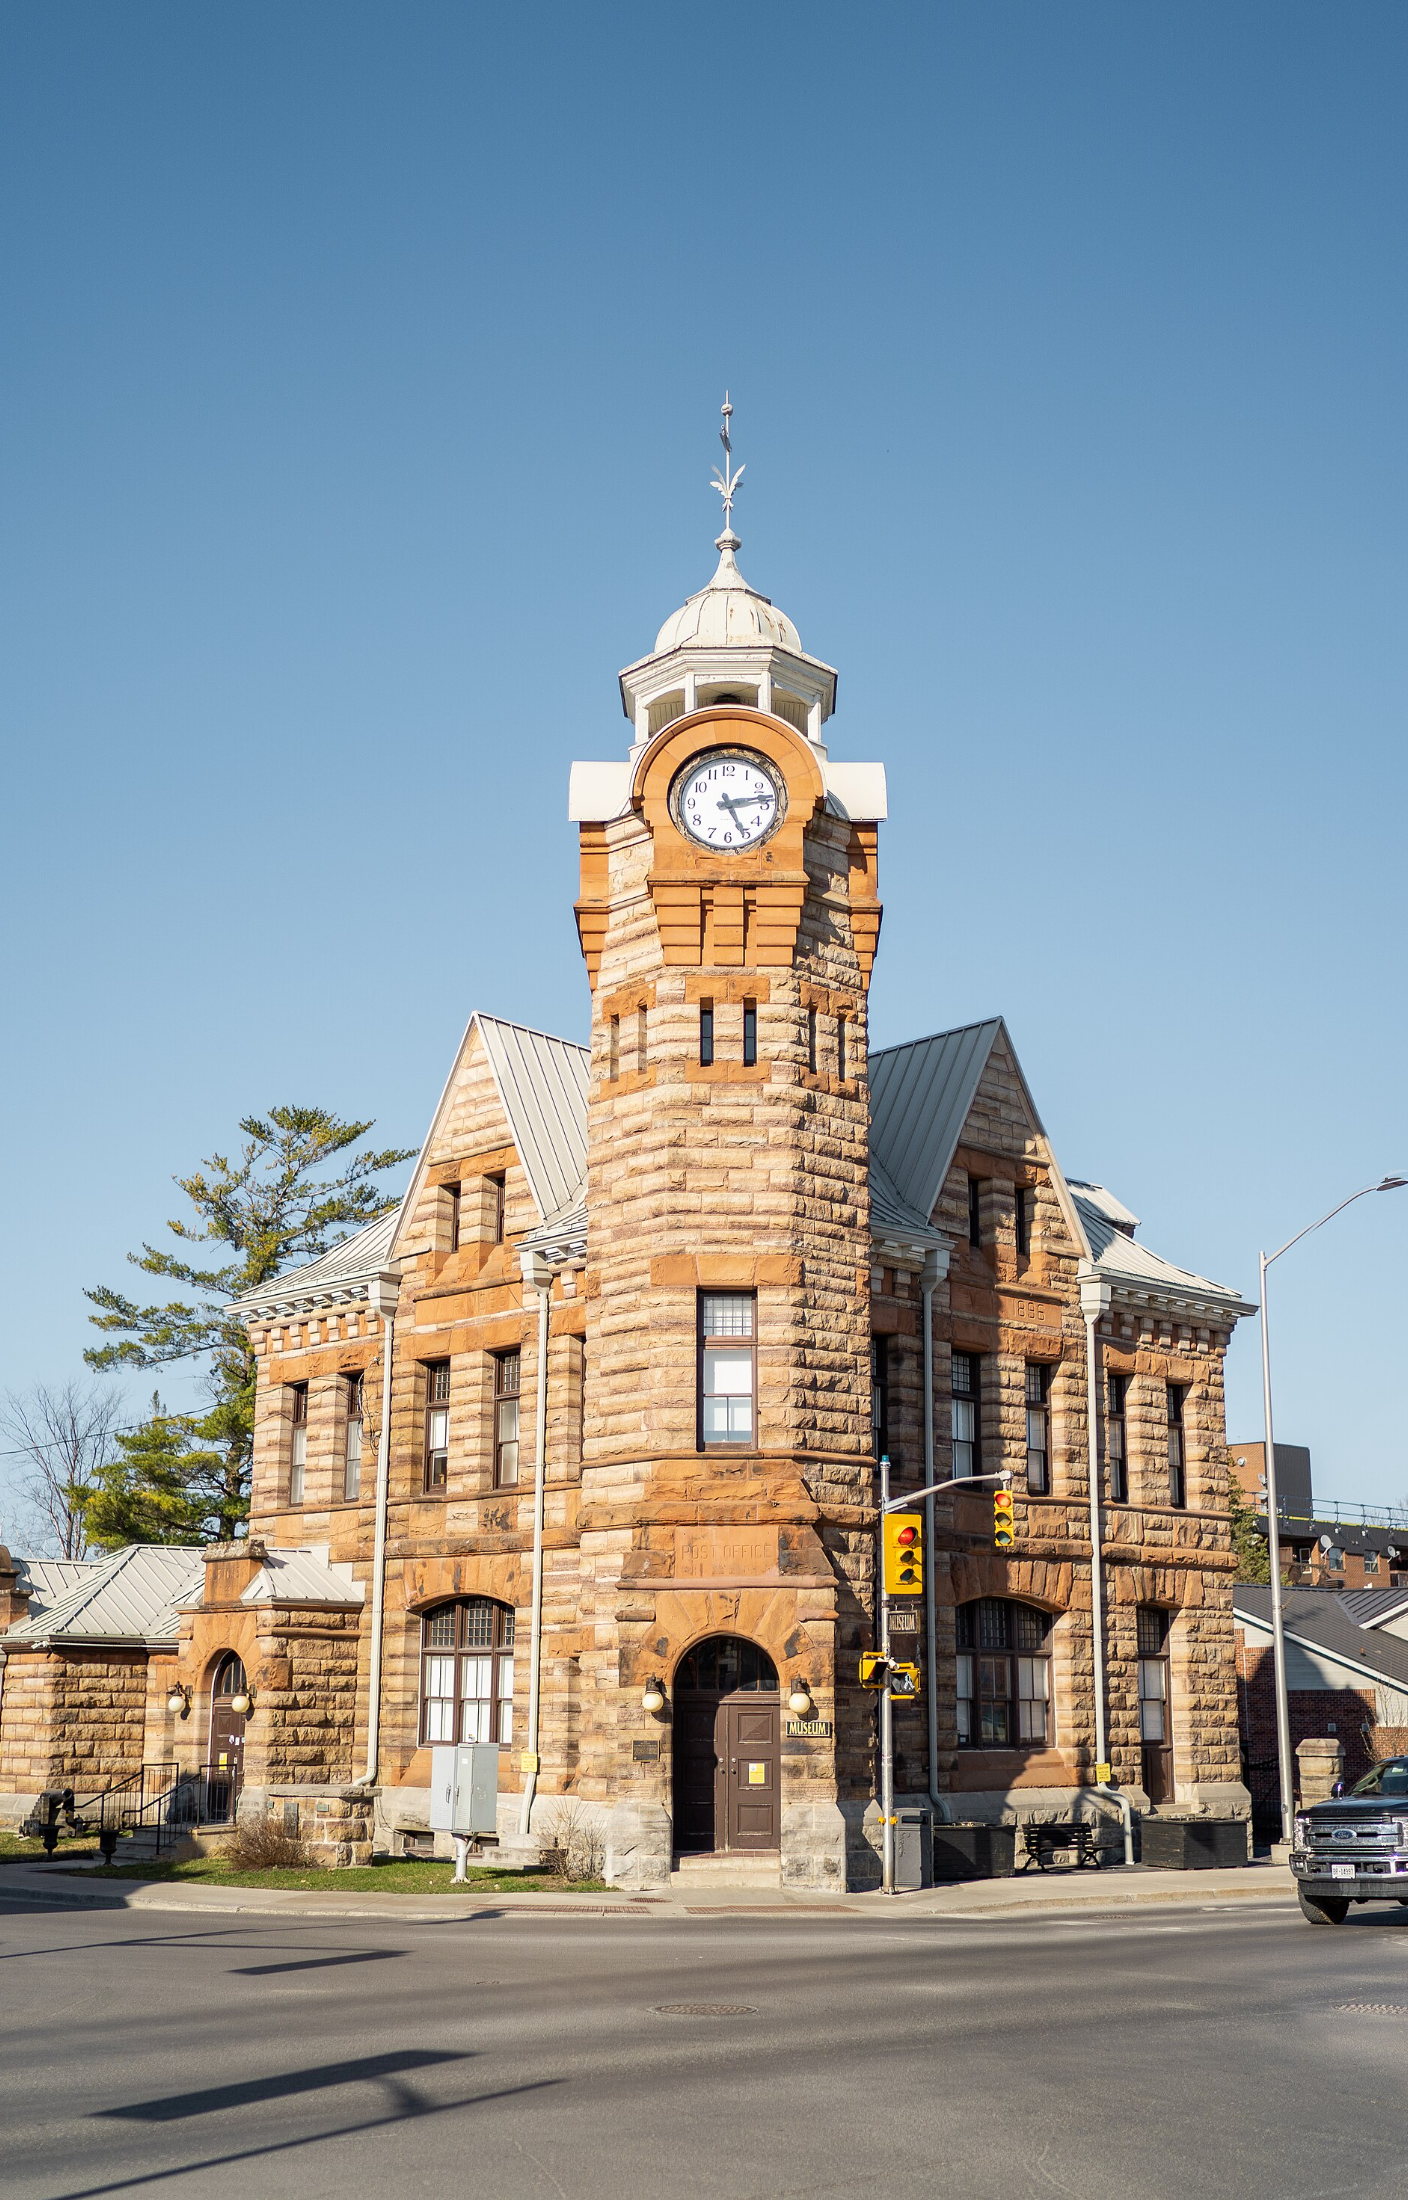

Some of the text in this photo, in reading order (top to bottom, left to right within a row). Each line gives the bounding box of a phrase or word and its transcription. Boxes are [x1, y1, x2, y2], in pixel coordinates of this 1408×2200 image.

[708, 769, 717, 780] 11
[722, 765, 735, 776] 12
[745, 770, 749, 780] 1
[694, 782, 707, 792] 10
[754, 782, 764, 794] 2
[688, 798, 696, 809] 9
[692, 814, 702, 826] 8
[751, 816, 762, 826] 4
[708, 828, 717, 838] 7
[724, 832, 732, 843] 6
[742, 828, 751, 839] 5
[1012, 1298, 1045, 1321] 1896
[681, 1544, 772, 1560] POST OFFICE
[889, 1614, 915, 1630] MUSEUM
[789, 1722, 826, 1734] MUSEUM
